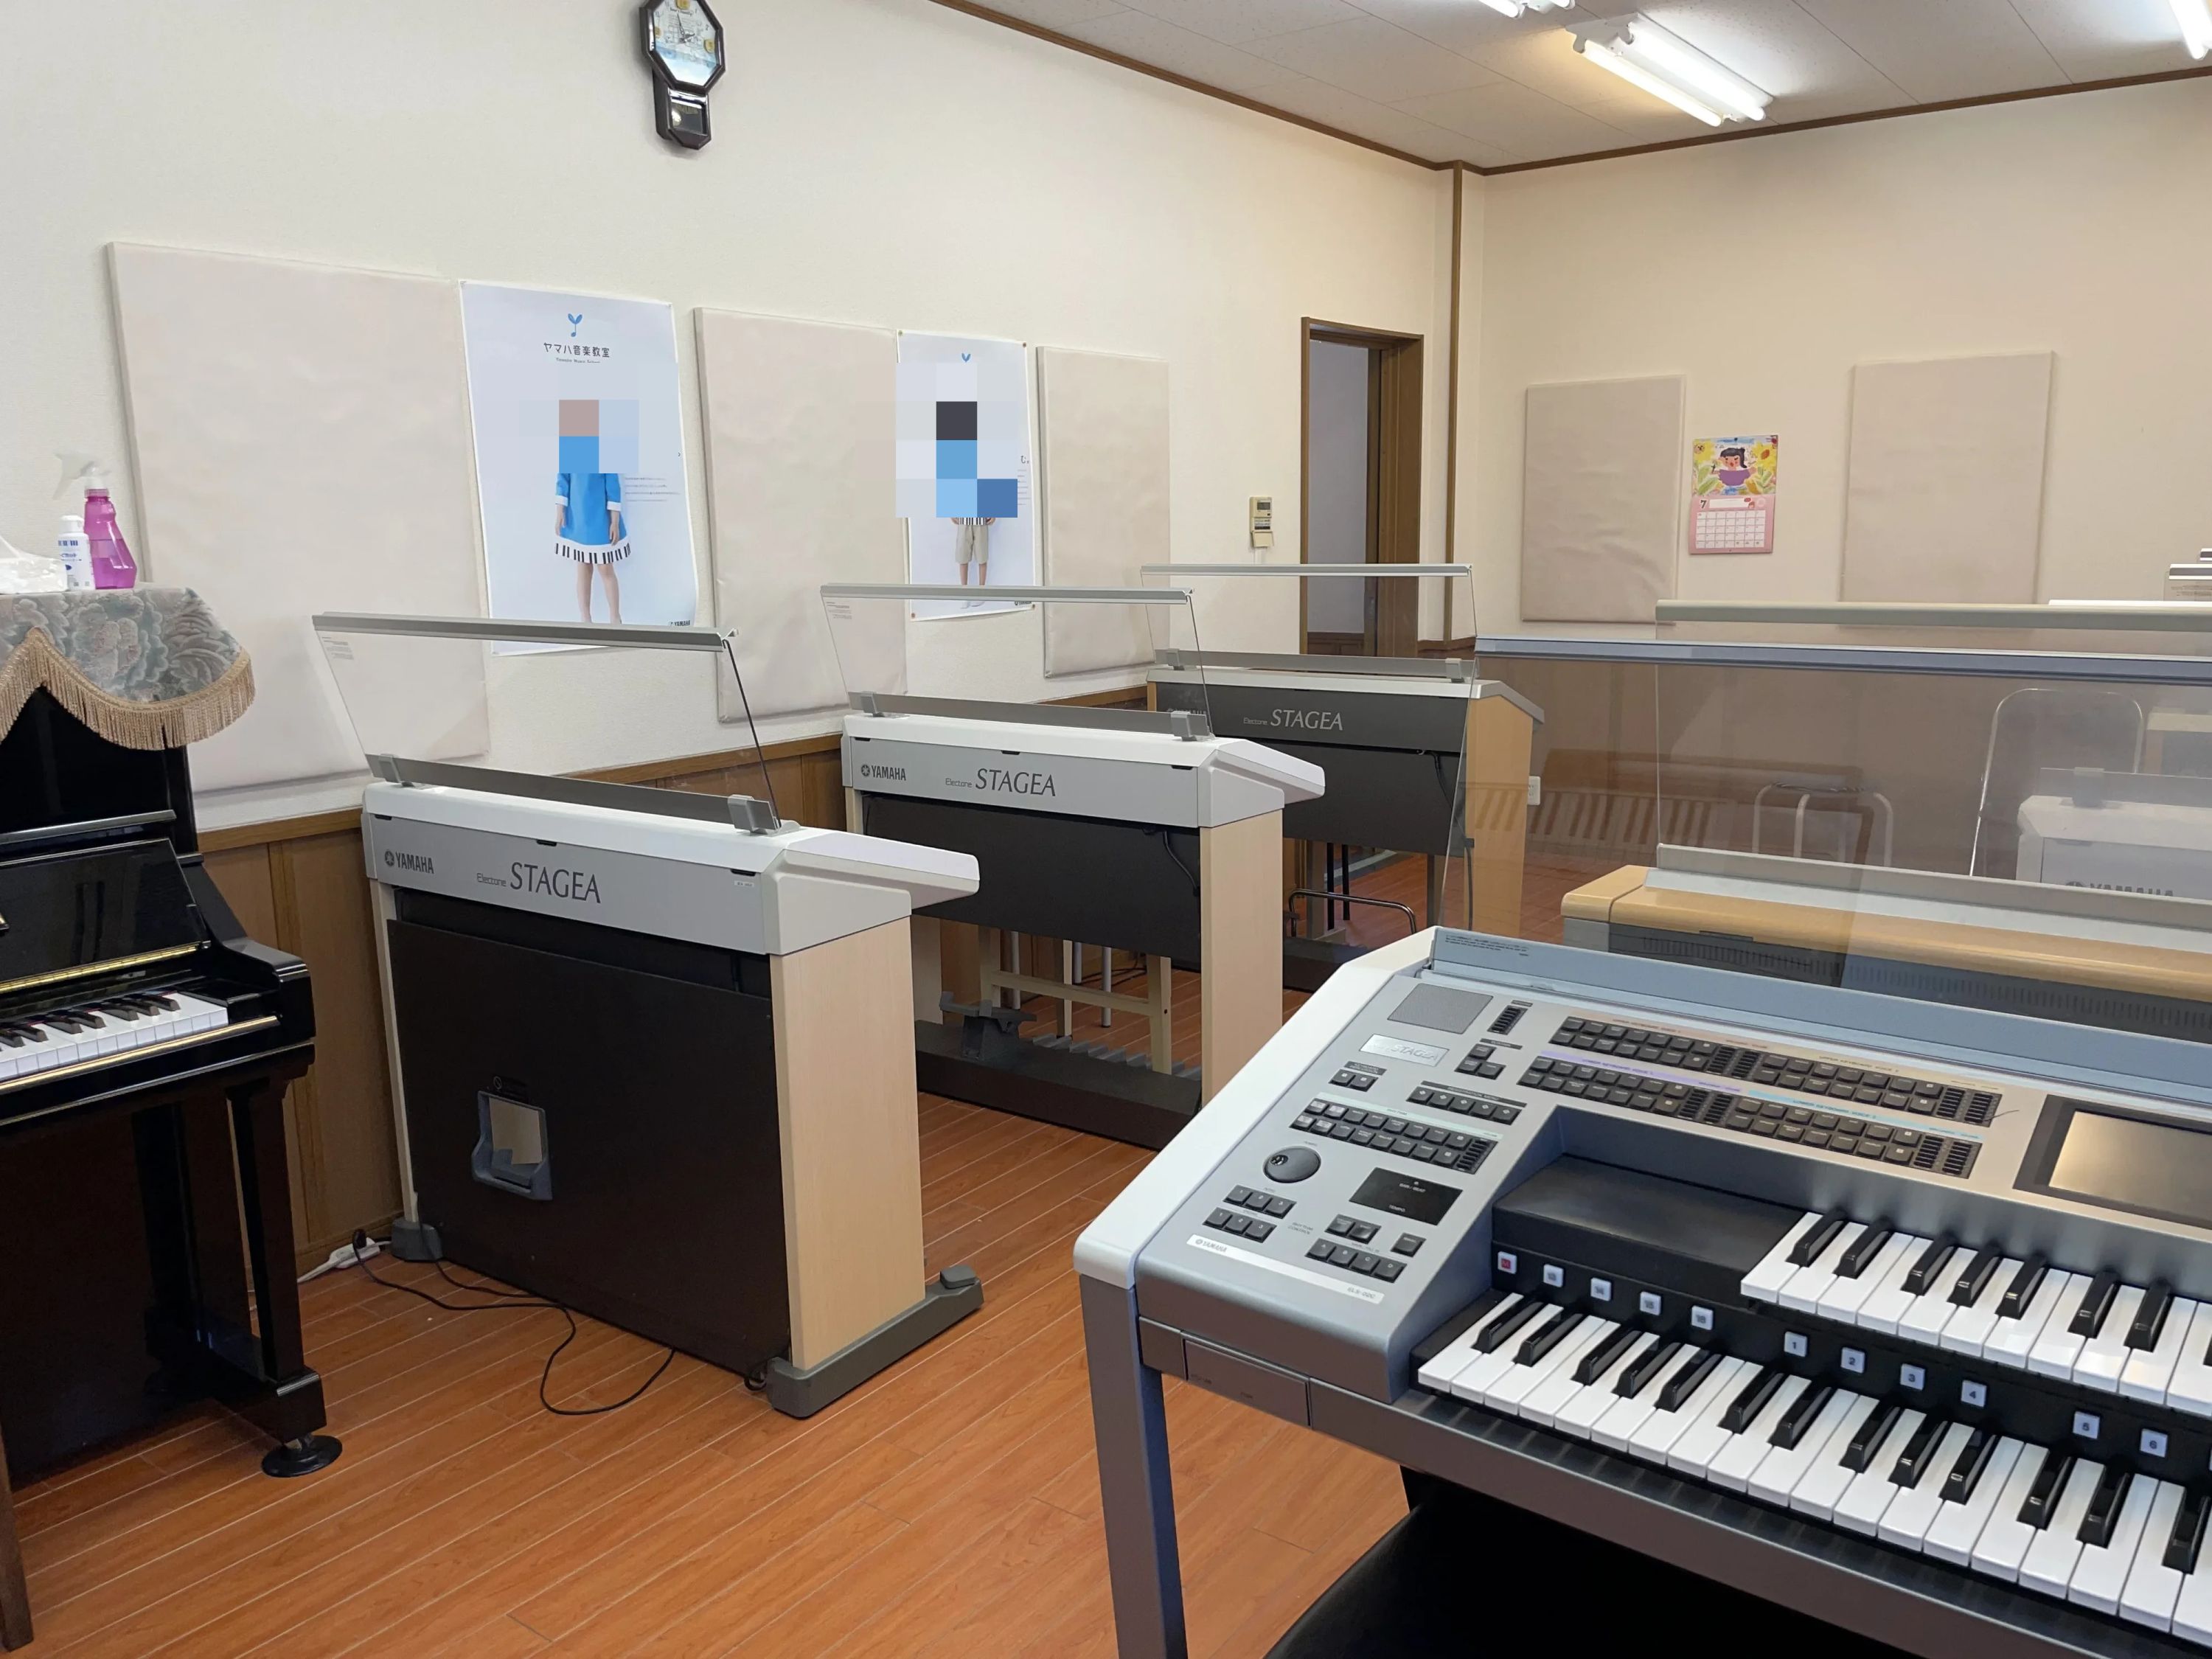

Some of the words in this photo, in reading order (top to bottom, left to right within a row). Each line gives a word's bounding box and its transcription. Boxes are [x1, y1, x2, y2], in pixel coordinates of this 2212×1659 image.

[543, 342, 611, 358] ヤマハ音楽教室
[1700, 499, 1707, 509] 7
[1243, 717, 1267, 726] Electone
[1270, 709, 1343, 731] STAGEA
[872, 765, 907, 781] YAMAHA
[945, 777, 973, 787] Electone
[975, 768, 1056, 796] STAGEA
[395, 852, 434, 874] YAMAHA
[476, 872, 507, 887] Electone
[510, 861, 601, 903] STAGEA
[1203, 1240, 1227, 1253] YAMAHA
[1908, 1374, 1916, 1382] 3
[1969, 1391, 1976, 1399] 4
[2082, 1422, 2090, 1431] 5
[2149, 1440, 2157, 1449] 6
